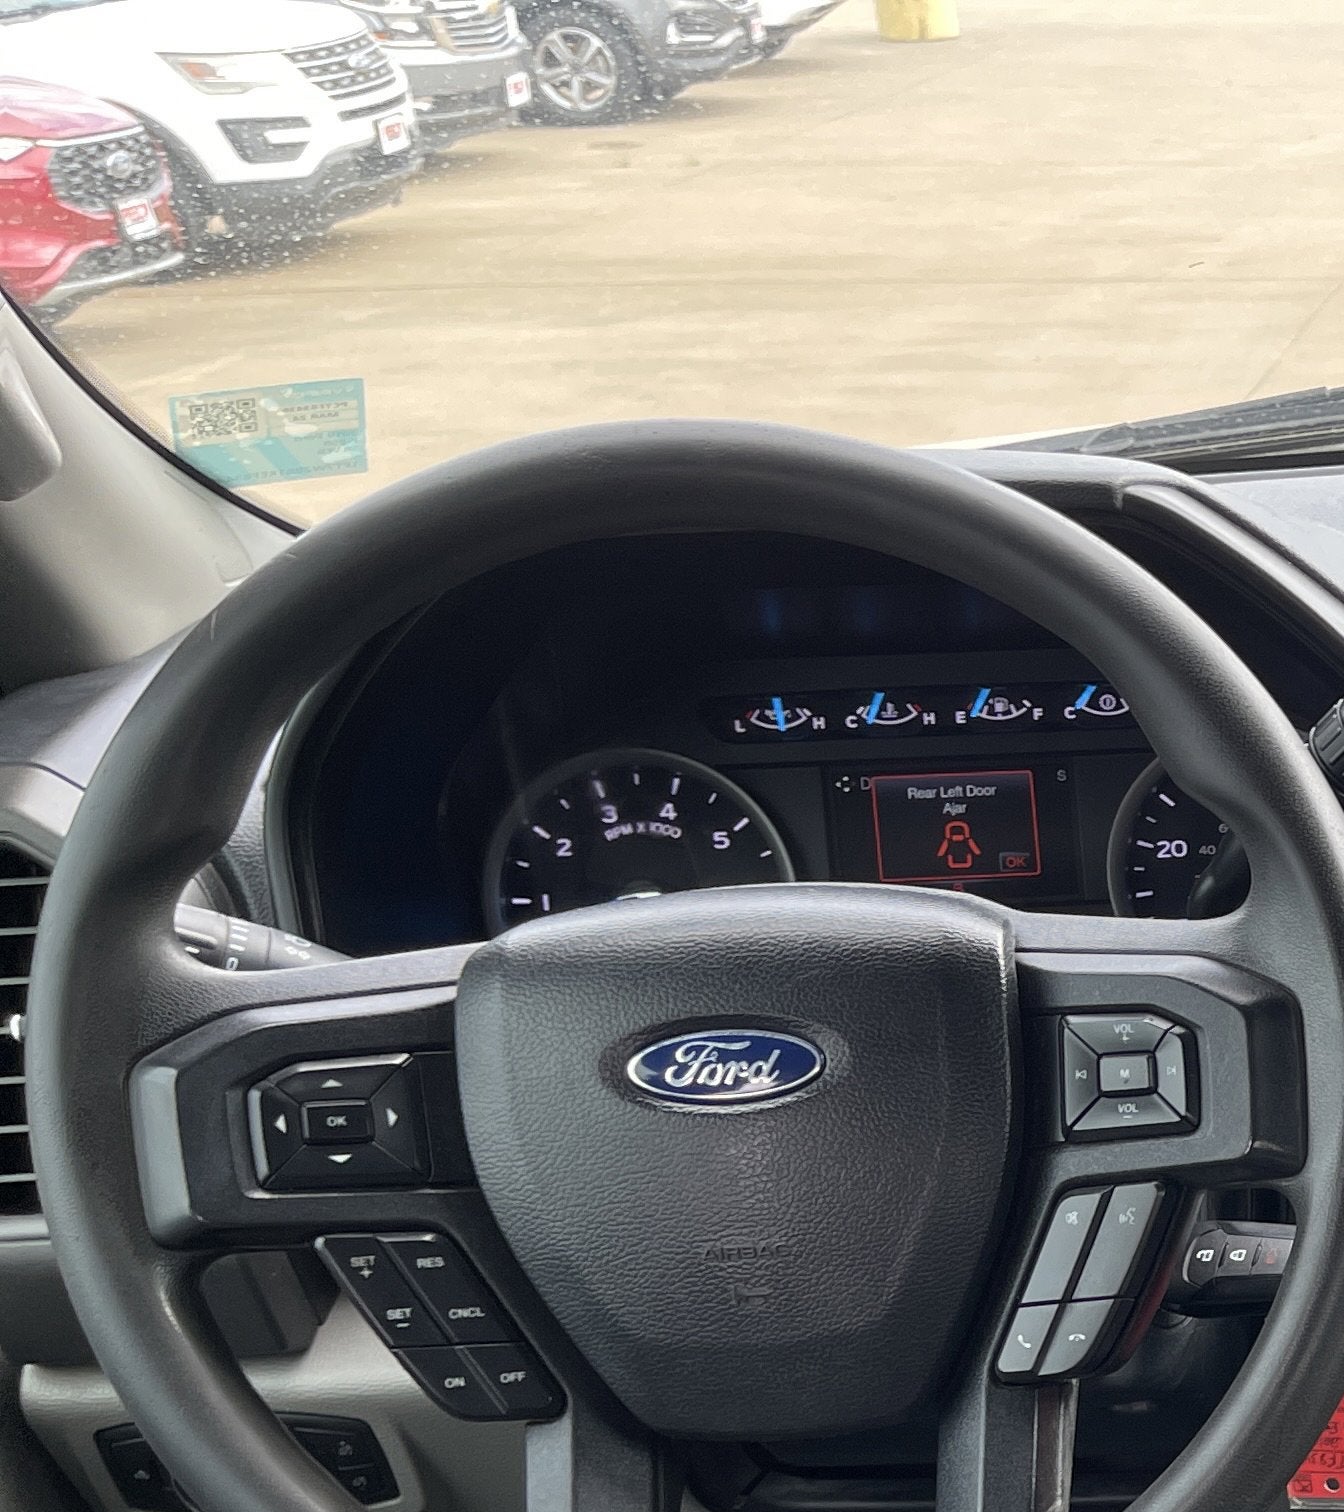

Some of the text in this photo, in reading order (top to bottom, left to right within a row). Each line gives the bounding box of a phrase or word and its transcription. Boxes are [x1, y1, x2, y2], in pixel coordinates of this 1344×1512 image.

[923, 712, 936, 725] H
[955, 711, 967, 724] E
[1032, 708, 1044, 720] F
[1063, 707, 1076, 719] C
[734, 720, 746, 733] L
[812, 716, 826, 730] H
[844, 715, 858, 728] C
[1057, 769, 1067, 782] S
[907, 784, 998, 799] Rear Left Door
[601, 804, 619, 824] 3
[659, 802, 678, 820] 4
[942, 802, 967, 816] Ajar
[604, 822, 634, 842] RPM
[649, 821, 682, 839] 1000
[712, 831, 731, 849] 5
[556, 838, 573, 857] 2
[1156, 839, 1188, 858] 20
[1198, 845, 1217, 855] 40
[1006, 856, 1027, 868] OK
[1113, 1024, 1134, 1034] VOL
[664, 1041, 781, 1087] Ford
[1117, 1103, 1139, 1113] VOL
[326, 1115, 348, 1127] OK
[350, 1255, 376, 1267] SET
[416, 1256, 445, 1269] RES
[386, 1308, 412, 1320] SET
[449, 1307, 485, 1319] CNCL
[444, 1377, 466, 1388] ON
[500, 1371, 526, 1383] OFF
